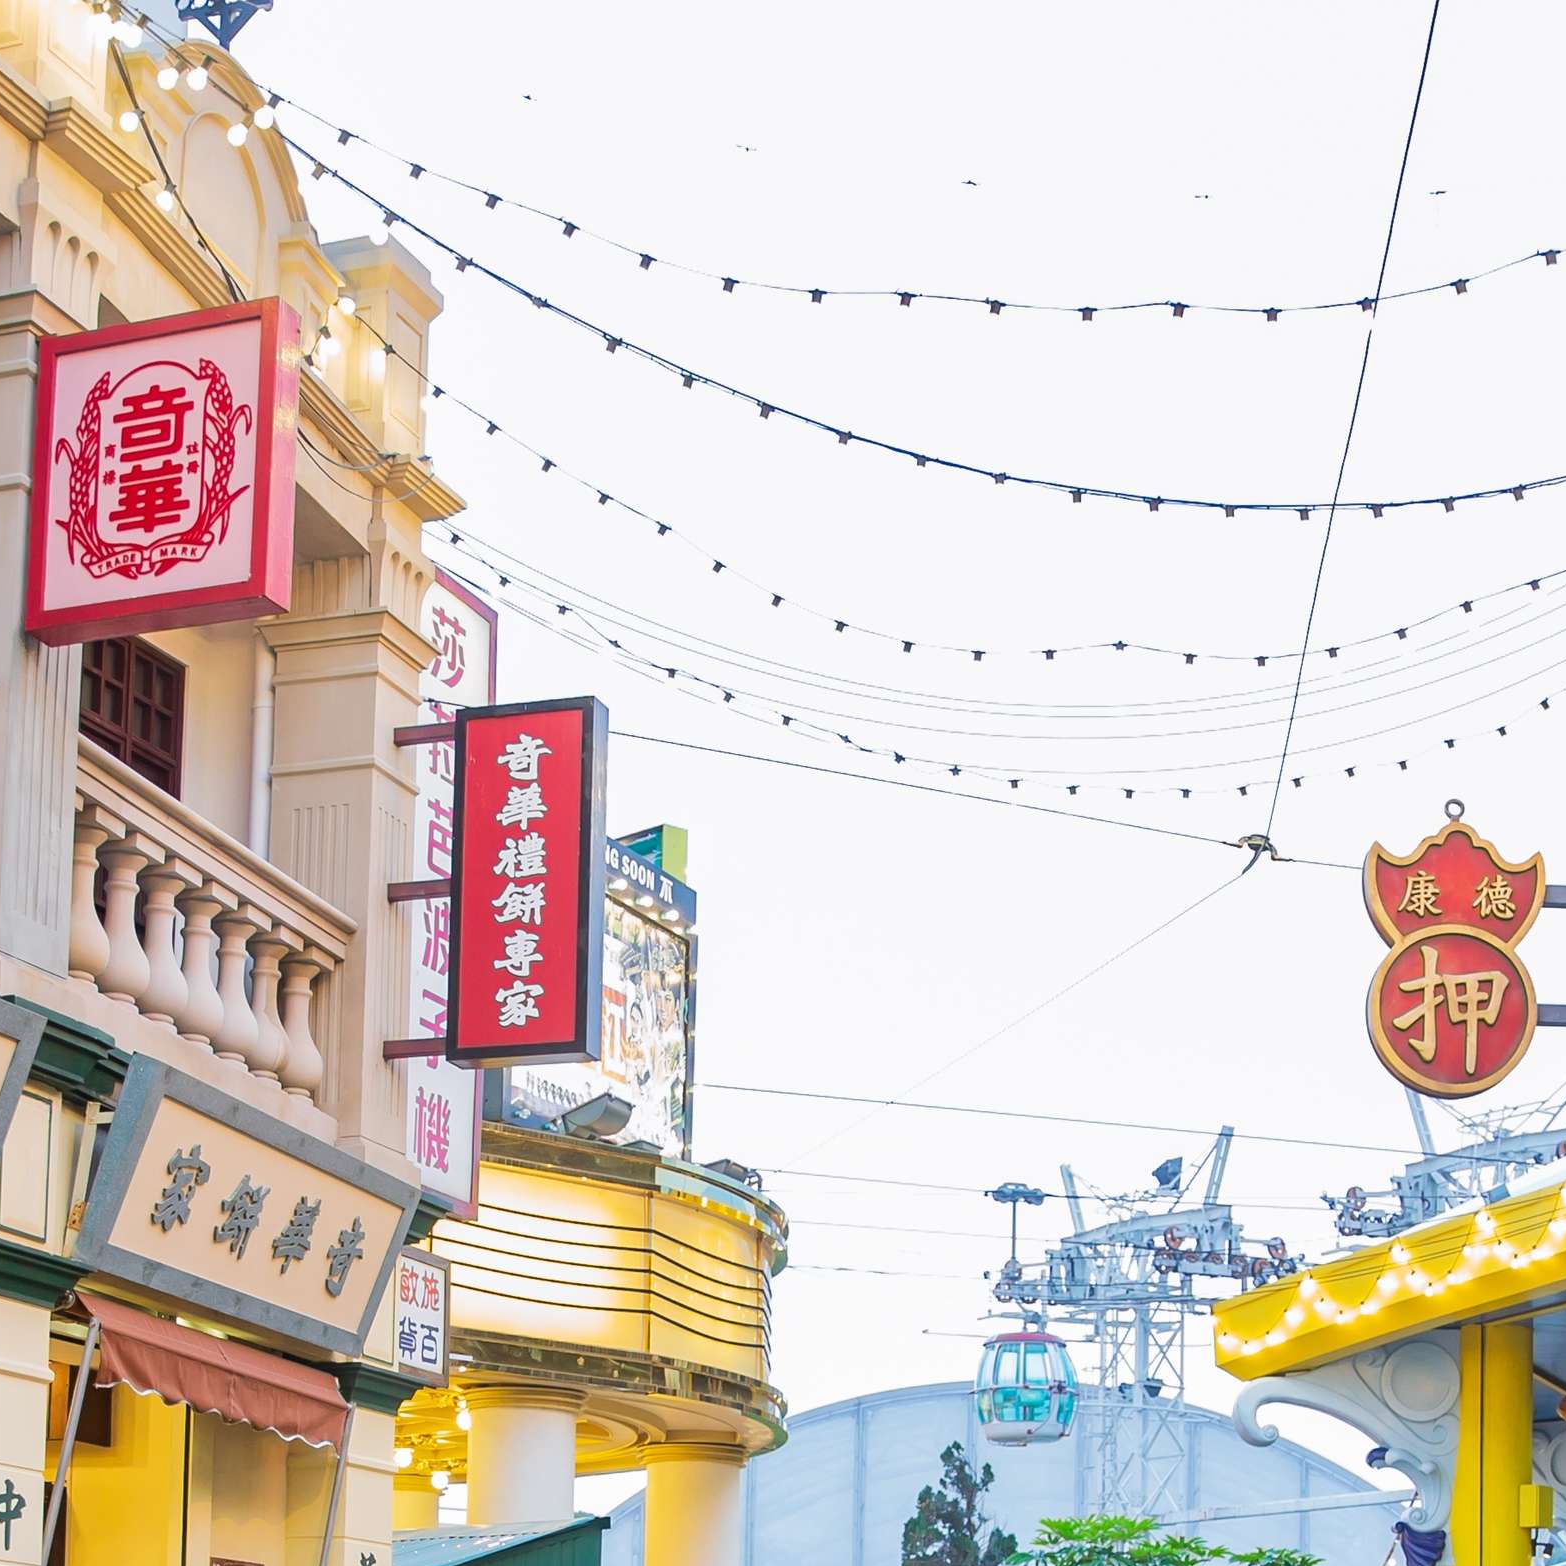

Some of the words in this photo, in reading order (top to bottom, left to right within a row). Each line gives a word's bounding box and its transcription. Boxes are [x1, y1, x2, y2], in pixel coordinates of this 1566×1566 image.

[109, 385, 194, 533] 奇華
[97, 553, 137, 573] TRADE
[160, 546, 198, 558] MARK
[492, 733, 552, 1027] 奇華禮餅專家
[621, 855, 655, 891] SOON
[1392, 944, 1510, 1075] 押
